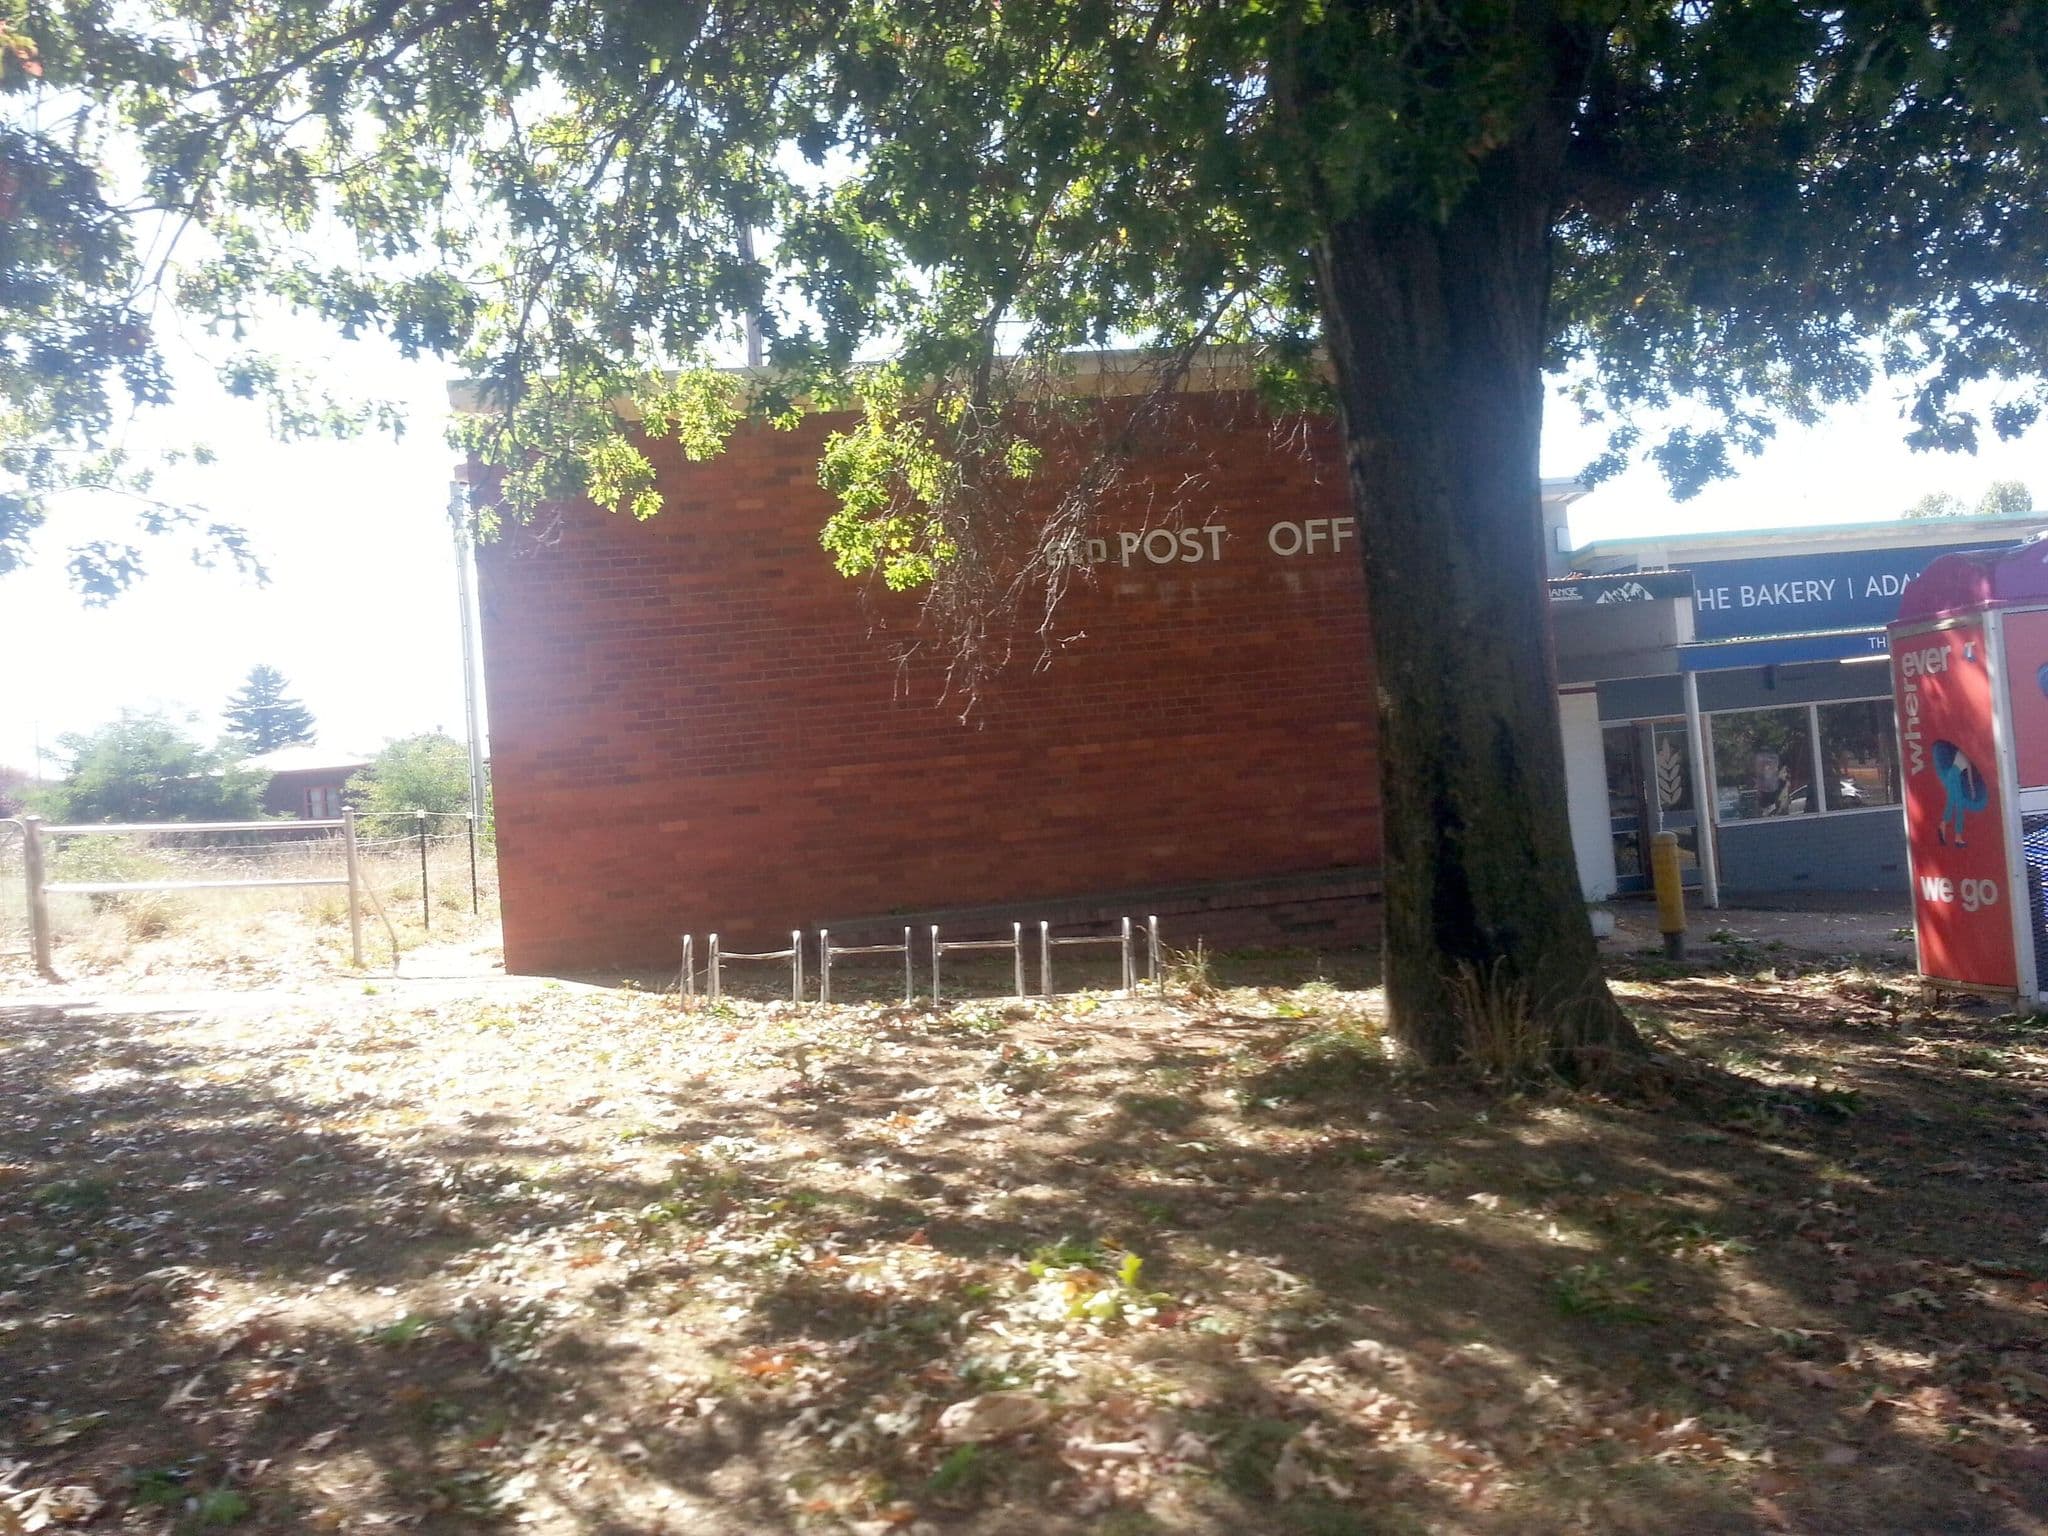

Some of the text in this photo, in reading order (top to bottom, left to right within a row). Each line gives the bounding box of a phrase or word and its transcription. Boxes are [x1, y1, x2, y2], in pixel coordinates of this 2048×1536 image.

[1120, 525, 1226, 568] POST
[1268, 517, 1354, 557] OFF
[1696, 572, 1920, 611] HE BAKERY ADA
[1867, 636, 1887, 649] TH
[1901, 644, 1952, 678] ever
[1920, 875, 1999, 912] we go
